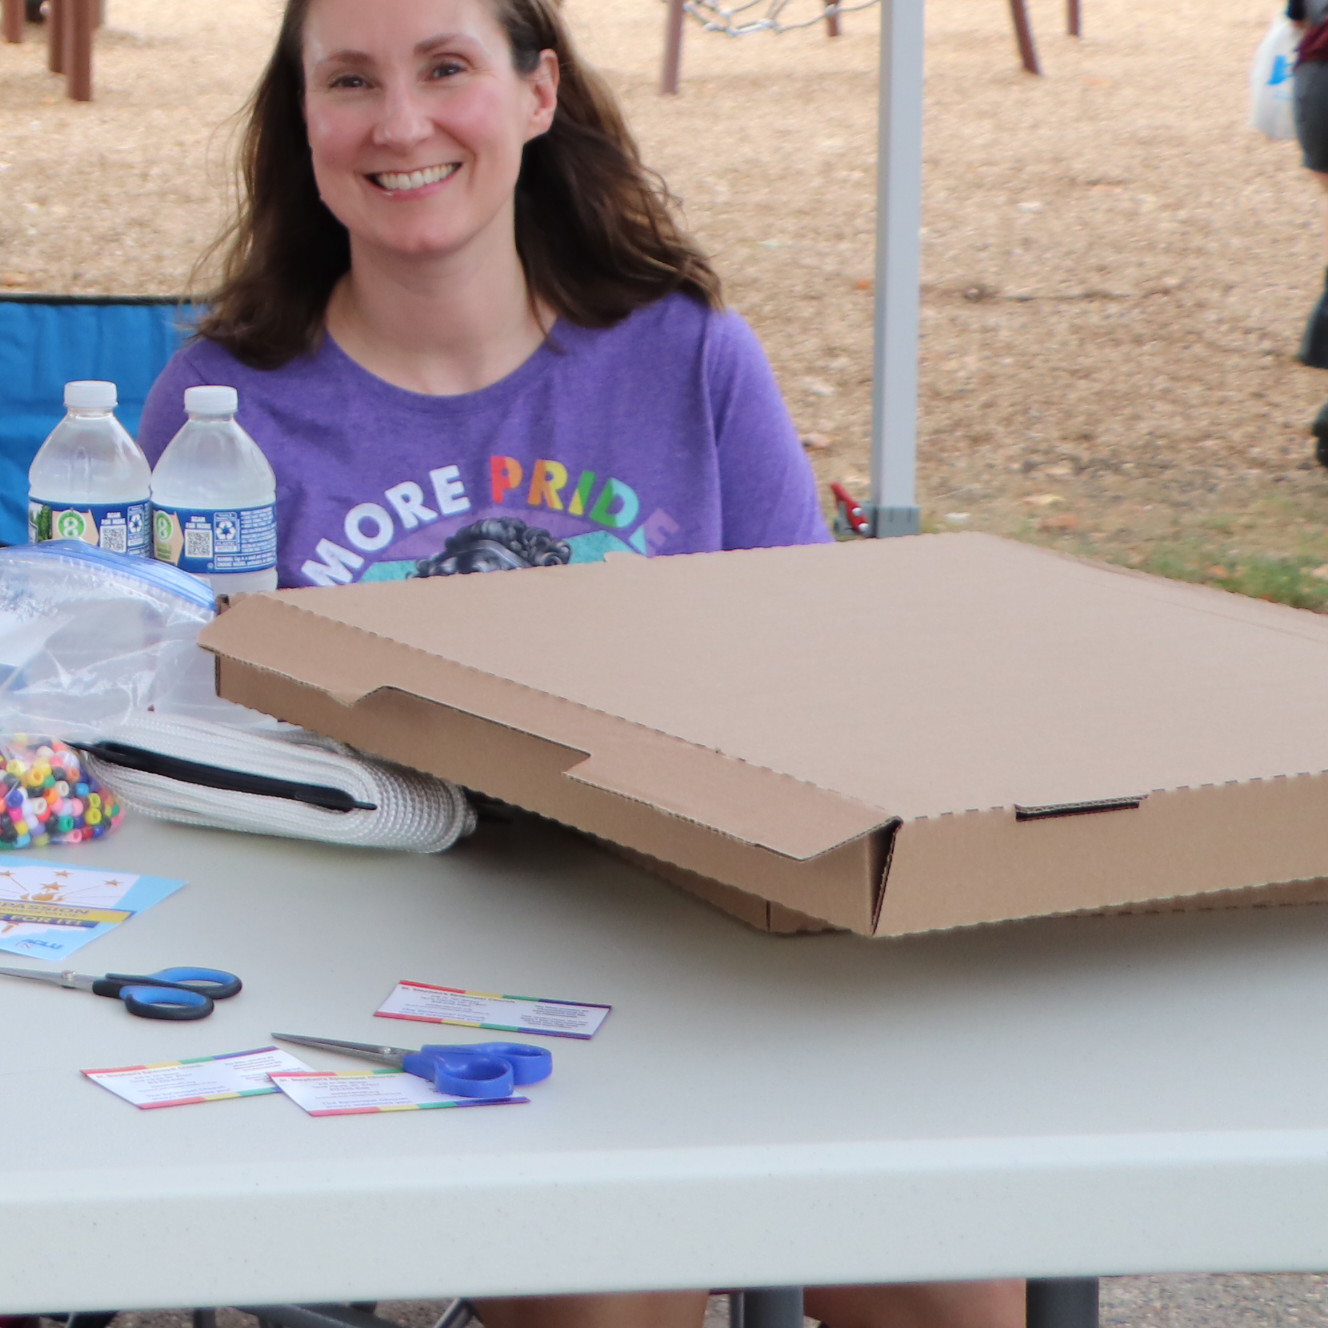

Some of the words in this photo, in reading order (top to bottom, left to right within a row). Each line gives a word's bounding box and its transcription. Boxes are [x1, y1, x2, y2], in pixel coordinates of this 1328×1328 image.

[301, 465, 471, 586] MORE
[489, 455, 680, 557] PRIDE
[10, 914, 51, 923] FOR
